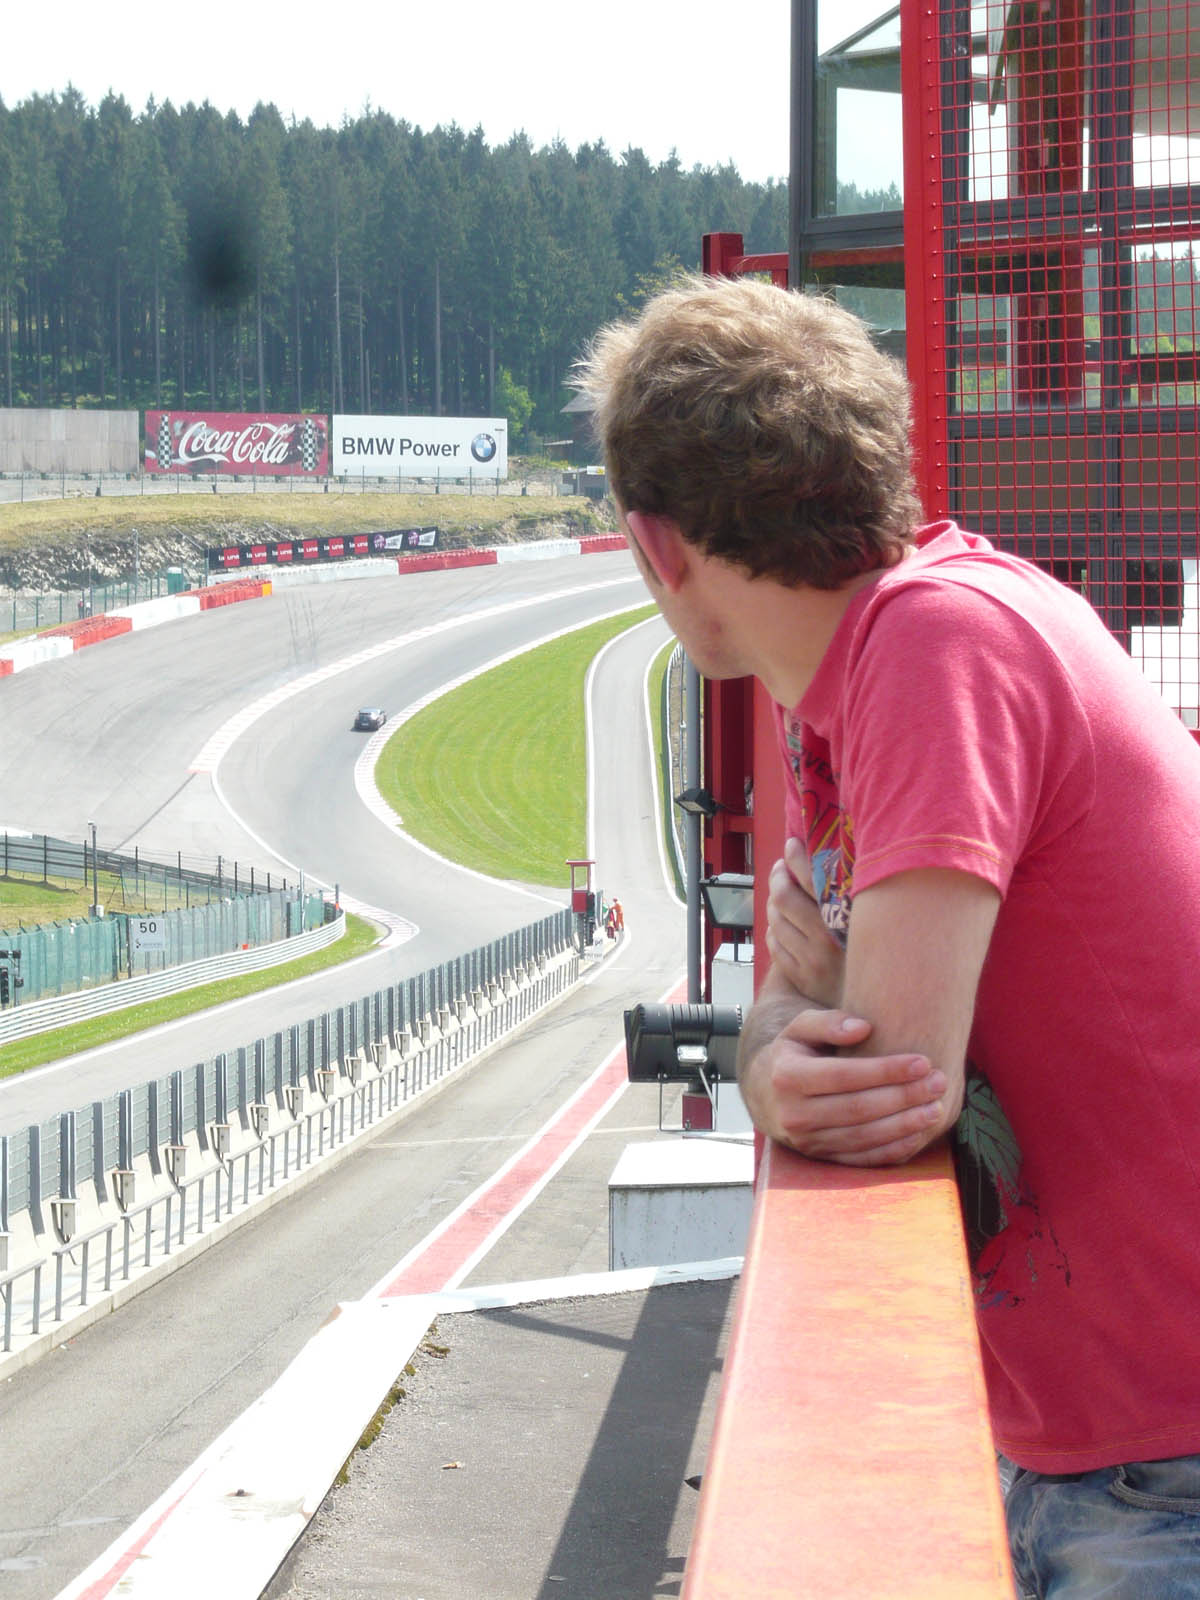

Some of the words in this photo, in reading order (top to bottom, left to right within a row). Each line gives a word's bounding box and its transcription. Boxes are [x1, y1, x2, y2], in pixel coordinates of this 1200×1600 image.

[178, 420, 295, 464] Coca-Cola
[342, 437, 395, 456] BMW
[399, 438, 461, 457] Power
[139, 921, 157, 933] 50
